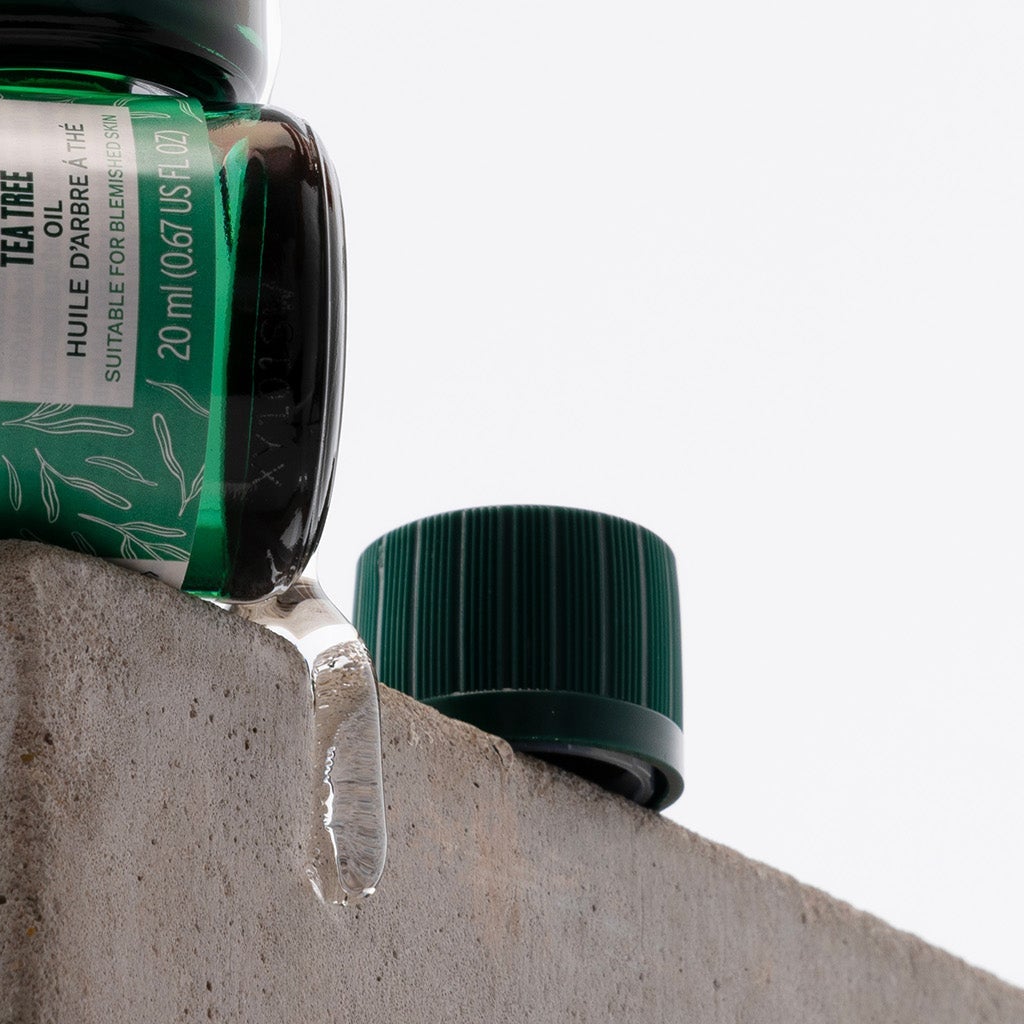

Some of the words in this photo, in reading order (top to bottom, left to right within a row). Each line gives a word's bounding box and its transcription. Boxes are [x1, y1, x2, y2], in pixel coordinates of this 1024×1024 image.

[58, 123, 85, 152] THÉ
[104, 115, 118, 139] SKIN
[155, 129, 191, 154] OZ)
[106, 141, 125, 232] BLEMISHED
[158, 158, 191, 181] FL
[0, 170, 34, 219] TREE
[159, 185, 192, 213] US
[43, 200, 63, 238] OIL
[0, 226, 34, 267] TEA
[109, 237, 125, 276] FOR
[159, 219, 197, 278] (0.67
[67, 279, 89, 357] HUILE
[160, 286, 192, 318] ml
[105, 282, 124, 382] SUITABLE
[157, 326, 191, 360] 20
